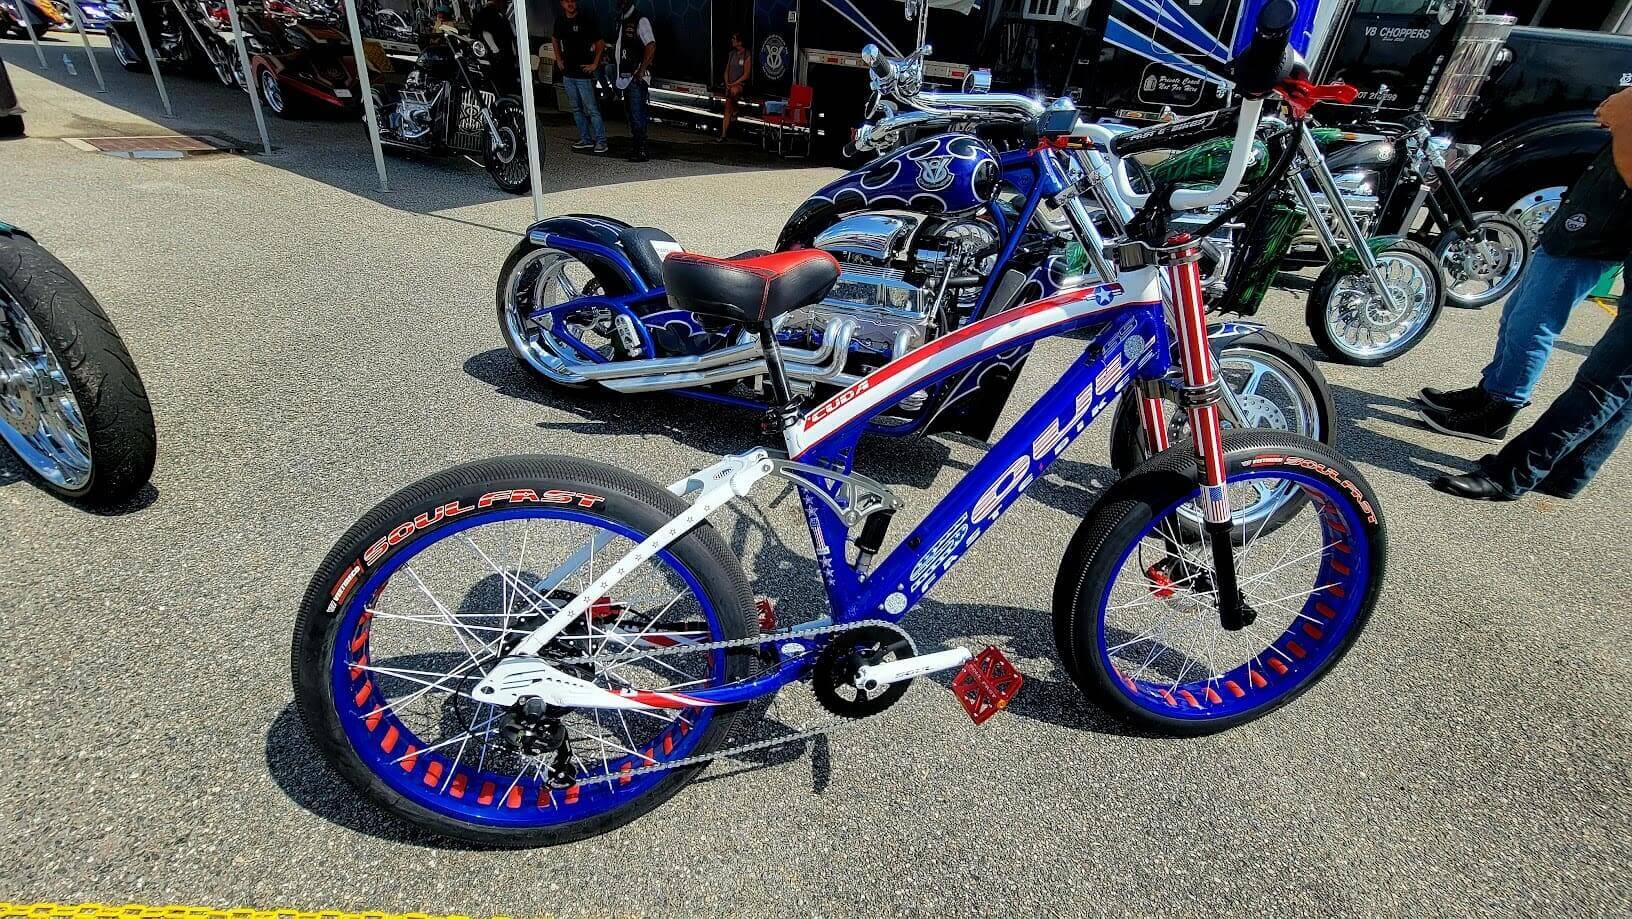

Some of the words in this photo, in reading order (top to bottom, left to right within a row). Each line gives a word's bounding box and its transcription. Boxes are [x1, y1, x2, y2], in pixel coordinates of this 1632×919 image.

[1365, 26, 1378, 37] V8
[1379, 27, 1431, 40] CHOPPERS
[1158, 82, 1171, 91] Not
[1171, 83, 1182, 92] For
[1283, 456, 1342, 484] SOUL
[1341, 479, 1379, 525] FAST
[363, 500, 475, 567] SOUL
[478, 488, 606, 509] FAST
[921, 504, 1003, 594] FAST
